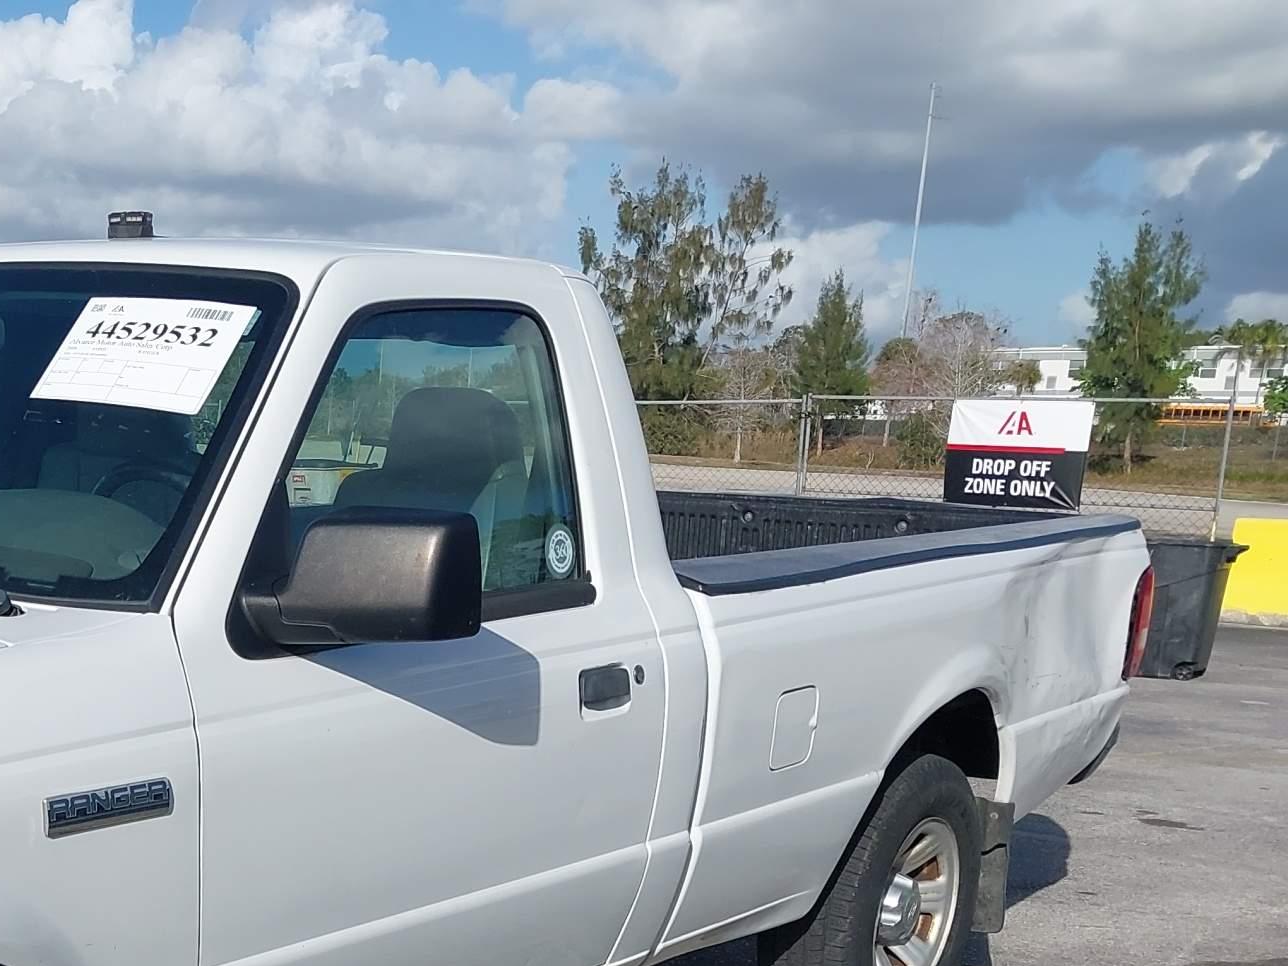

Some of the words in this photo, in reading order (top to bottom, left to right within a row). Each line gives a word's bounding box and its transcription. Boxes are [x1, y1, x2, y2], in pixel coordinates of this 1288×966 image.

[86, 320, 219, 348] 44529532
[972, 458, 1016, 476] DROP
[1019, 460, 1052, 478] OFF
[964, 477, 1006, 495] ZONE
[1009, 479, 1056, 498] ONLY
[47, 780, 170, 822] RANGER
